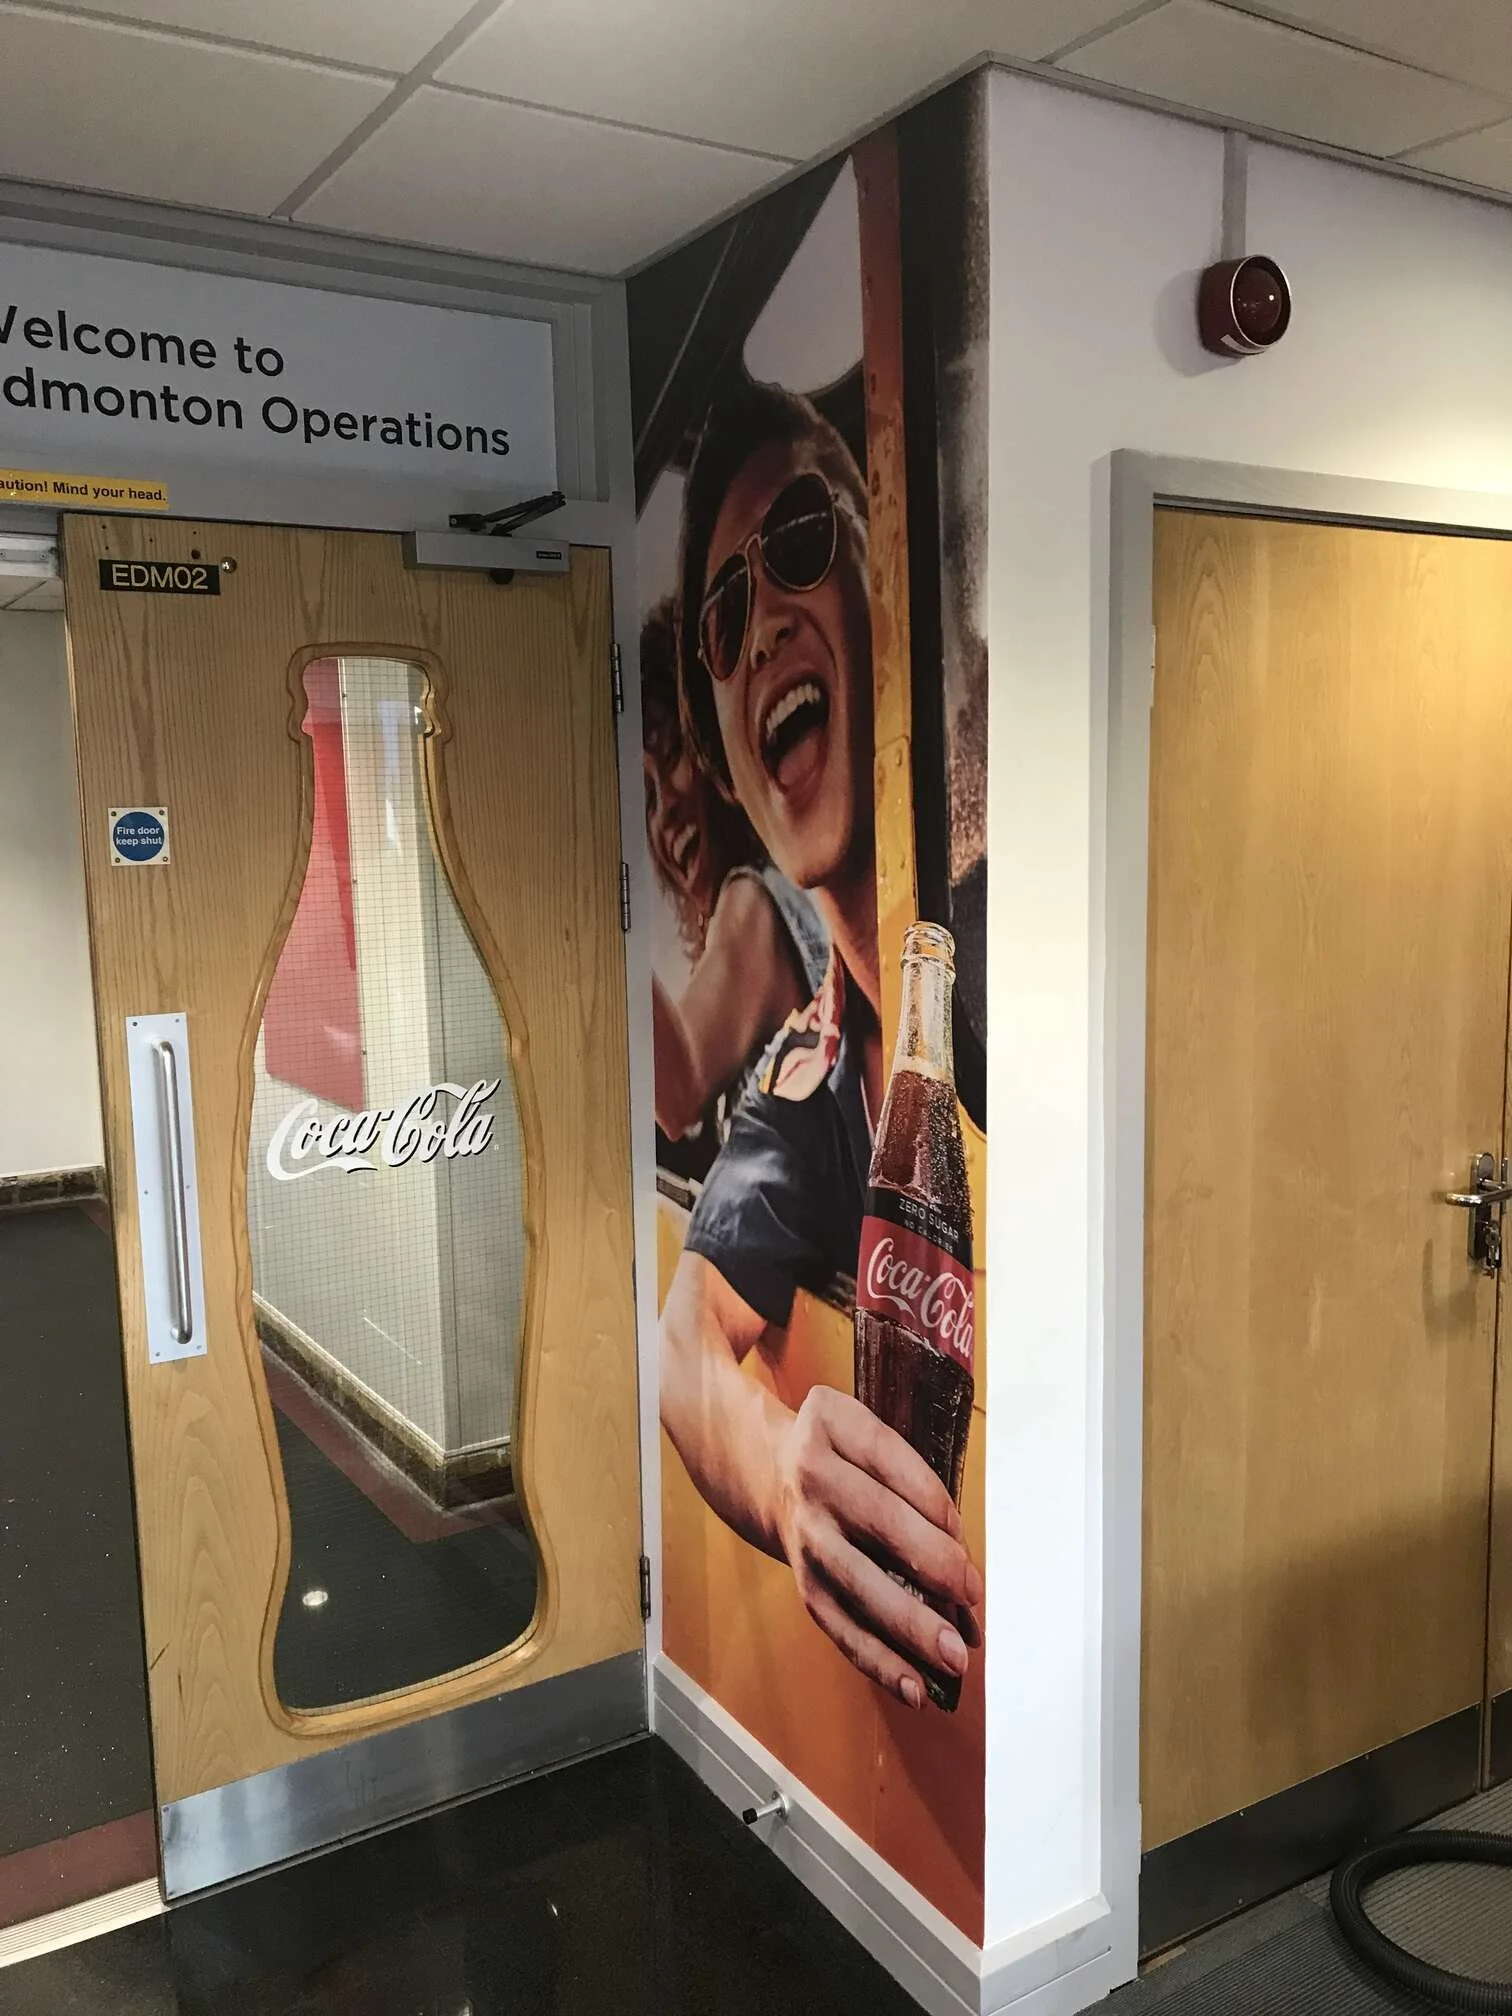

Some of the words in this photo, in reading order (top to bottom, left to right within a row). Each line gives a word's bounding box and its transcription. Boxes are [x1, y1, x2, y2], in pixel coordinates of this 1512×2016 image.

[234, 337, 284, 376] to
[3, 366, 242, 429] dmonton
[262, 396, 510, 456] Operations
[0, 479, 48, 493] aution!
[53, 482, 88, 496] Mind
[93, 487, 125, 499] your
[129, 488, 167, 501] head.
[116, 826, 135, 835] Fire
[137, 826, 160, 835] door
[116, 837, 139, 847] keep
[140, 836, 162, 845] shut
[266, 1078, 501, 1181] Coca-Cola
[898, 1197, 926, 1221] ZERO
[928, 1213, 960, 1242] SUGAR
[866, 1237, 974, 1358] Coca-Cola
